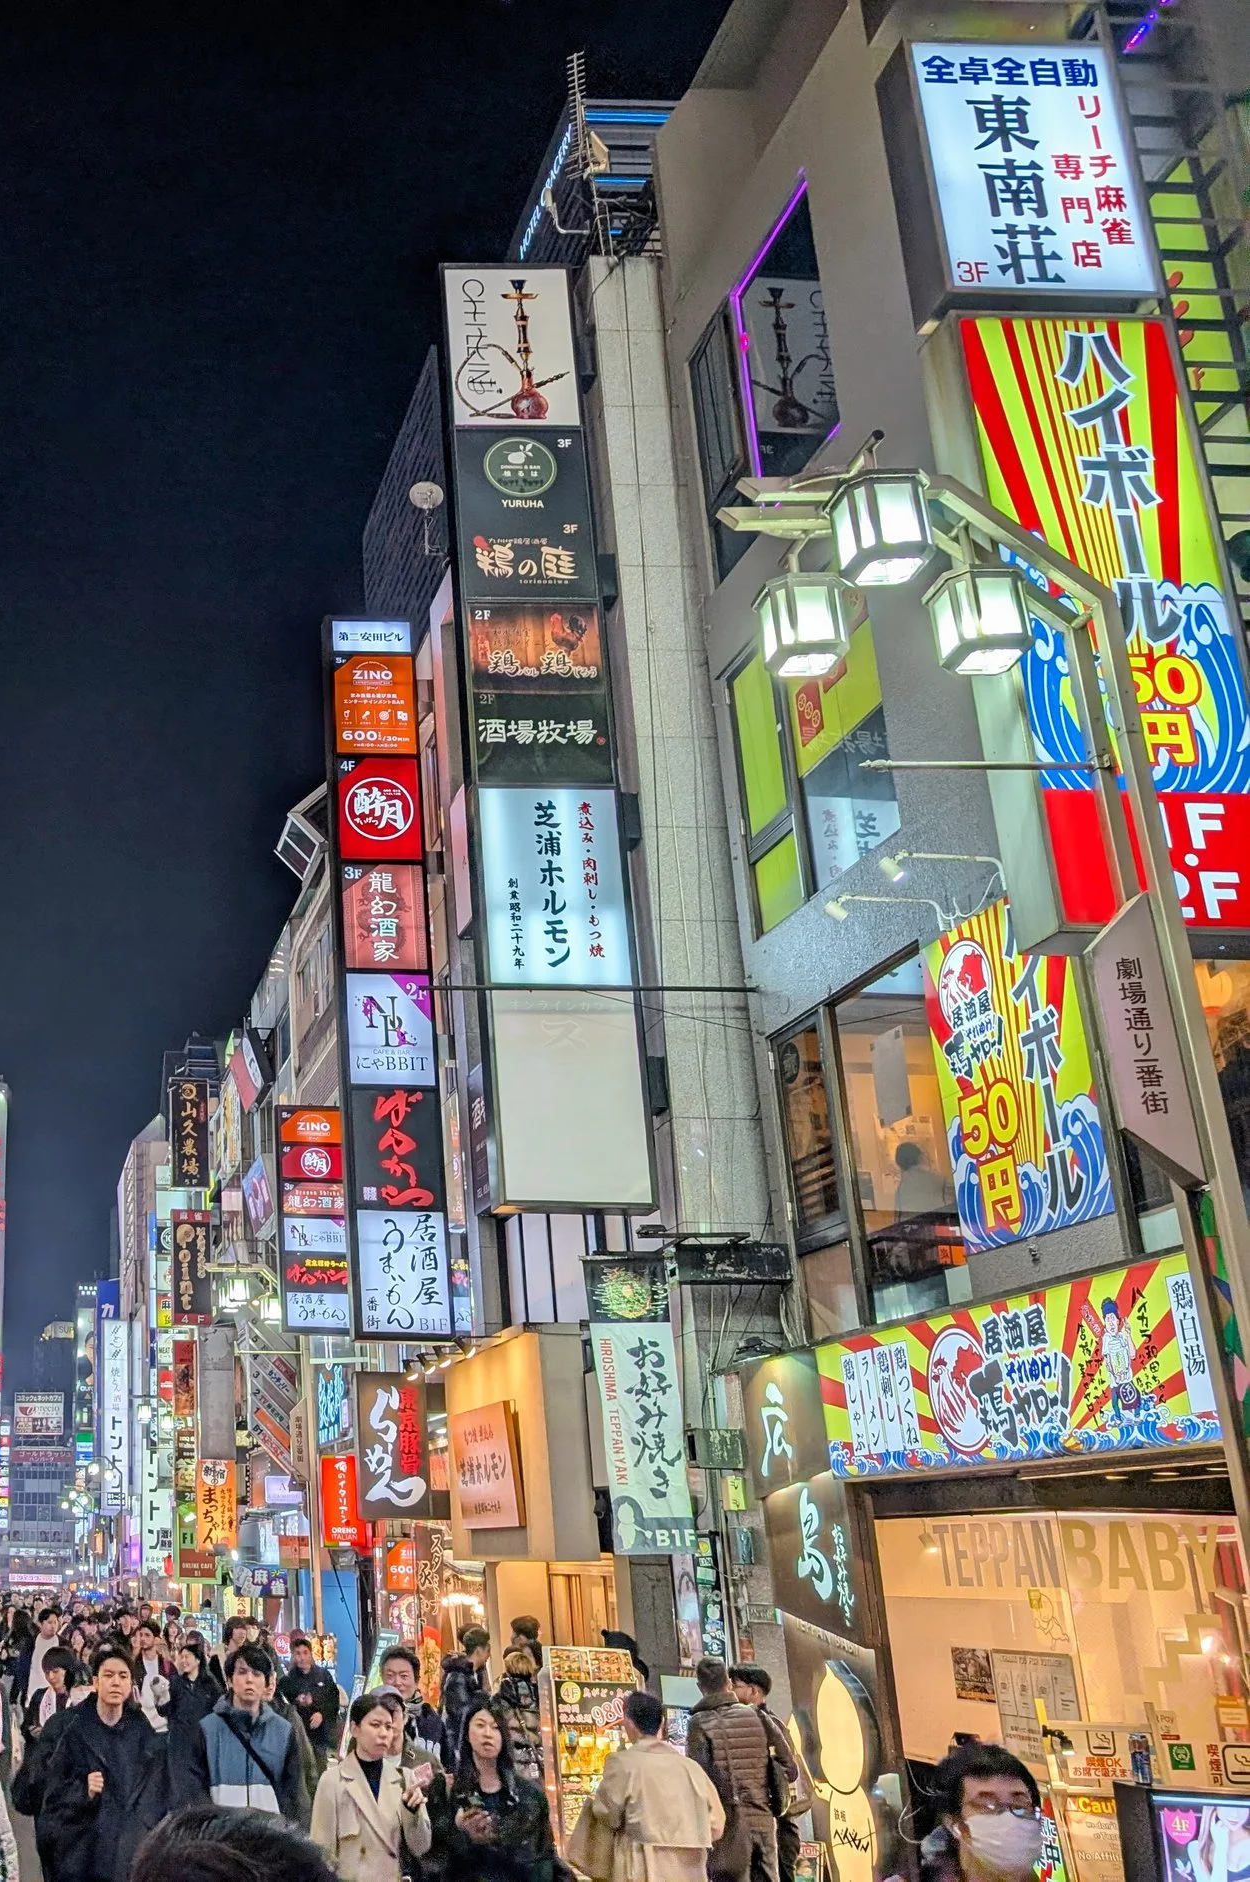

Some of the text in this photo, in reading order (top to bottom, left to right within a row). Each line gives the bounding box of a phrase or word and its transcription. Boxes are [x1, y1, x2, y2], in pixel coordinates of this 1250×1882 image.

[921, 55, 1099, 87] 全卓全自動
[965, 93, 1067, 286] 東南荘
[1078, 95, 1136, 246] リーチ麻雀
[1051, 153, 1103, 269] 専門店
[956, 260, 990, 283] 3F
[557, 438, 572, 448] 3F
[501, 499, 544, 509] YURUHA
[1055, 330, 1187, 647] ハイボール
[563, 524, 578, 534] 3F
[474, 609, 491, 620] 2F
[338, 631, 405, 642] 第二安田ビル
[352, 670, 393, 680] ZINO
[1130, 654, 1203, 707] 50
[479, 693, 496, 704] 2F
[342, 730, 378, 741] 600
[478, 718, 598, 745] 酒場牧場
[1142, 711, 1198, 768] 円
[340, 760, 355, 772] 4F
[353, 786, 406, 831] 酔月
[344, 866, 363, 879] 3F
[533, 799, 571, 968] 芝浦ホルモン
[577, 801, 606, 959] 煮込み・肉刺し・もつ焼
[368, 871, 400, 963] 龍幻酒家
[507, 877, 526, 971] 創業昭和二十九年
[406, 982, 428, 1001] 2F
[951, 990, 992, 1031] 居酒屋
[373, 1048, 411, 1057] CAFE BAR
[1116, 956, 1169, 1116] 劇場通り一番街
[355, 1055, 429, 1072] にゃBBIT
[296, 1121, 331, 1132] ZINO
[958, 1078, 1020, 1158] 50
[284, 1183, 294, 1191] 3F
[978, 1153, 1022, 1235] 円
[179, 1212, 203, 1221] 麻雀
[176, 1223, 196, 1311] Point
[379, 1217, 415, 1330] うまいもん
[409, 1213, 444, 1306] 居酒屋
[181, 1314, 205, 1324] 4F
[289, 1293, 327, 1306] 居酒屋
[365, 1288, 381, 1330] 一番街
[418, 1317, 448, 1331] B1F
[983, 1307, 1048, 1355] 居酒屋
[1172, 1278, 1209, 1377] 鶏白湯
[599, 1337, 617, 1401] HIROSHIMA
[876, 1350, 897, 1424] 鶏刺し
[842, 1358, 866, 1453] 鶏しゃぶ
[859, 1355, 883, 1447] ラーメン
[893, 1345, 921, 1446] 鶏つくね
[624, 1336, 684, 1499] お好み焼き
[334, 1460, 348, 1524] 俺のイタリアン
[202, 1486, 221, 1546] まっちゃん
[331, 1533, 358, 1541] ITALIAN
[654, 1528, 696, 1548] B1F
[932, 1519, 1221, 1592] TEPPAN BABY
[390, 1565, 414, 1574] 600
[562, 1687, 580, 1699] 4F
[590, 1696, 625, 1728] 980
[1160, 1714, 1175, 1724] Pay
[1086, 1756, 1123, 1768] 喫煙OK
[1207, 1743, 1224, 1787] 喫煙可
[1171, 1816, 1190, 1832] 4F
